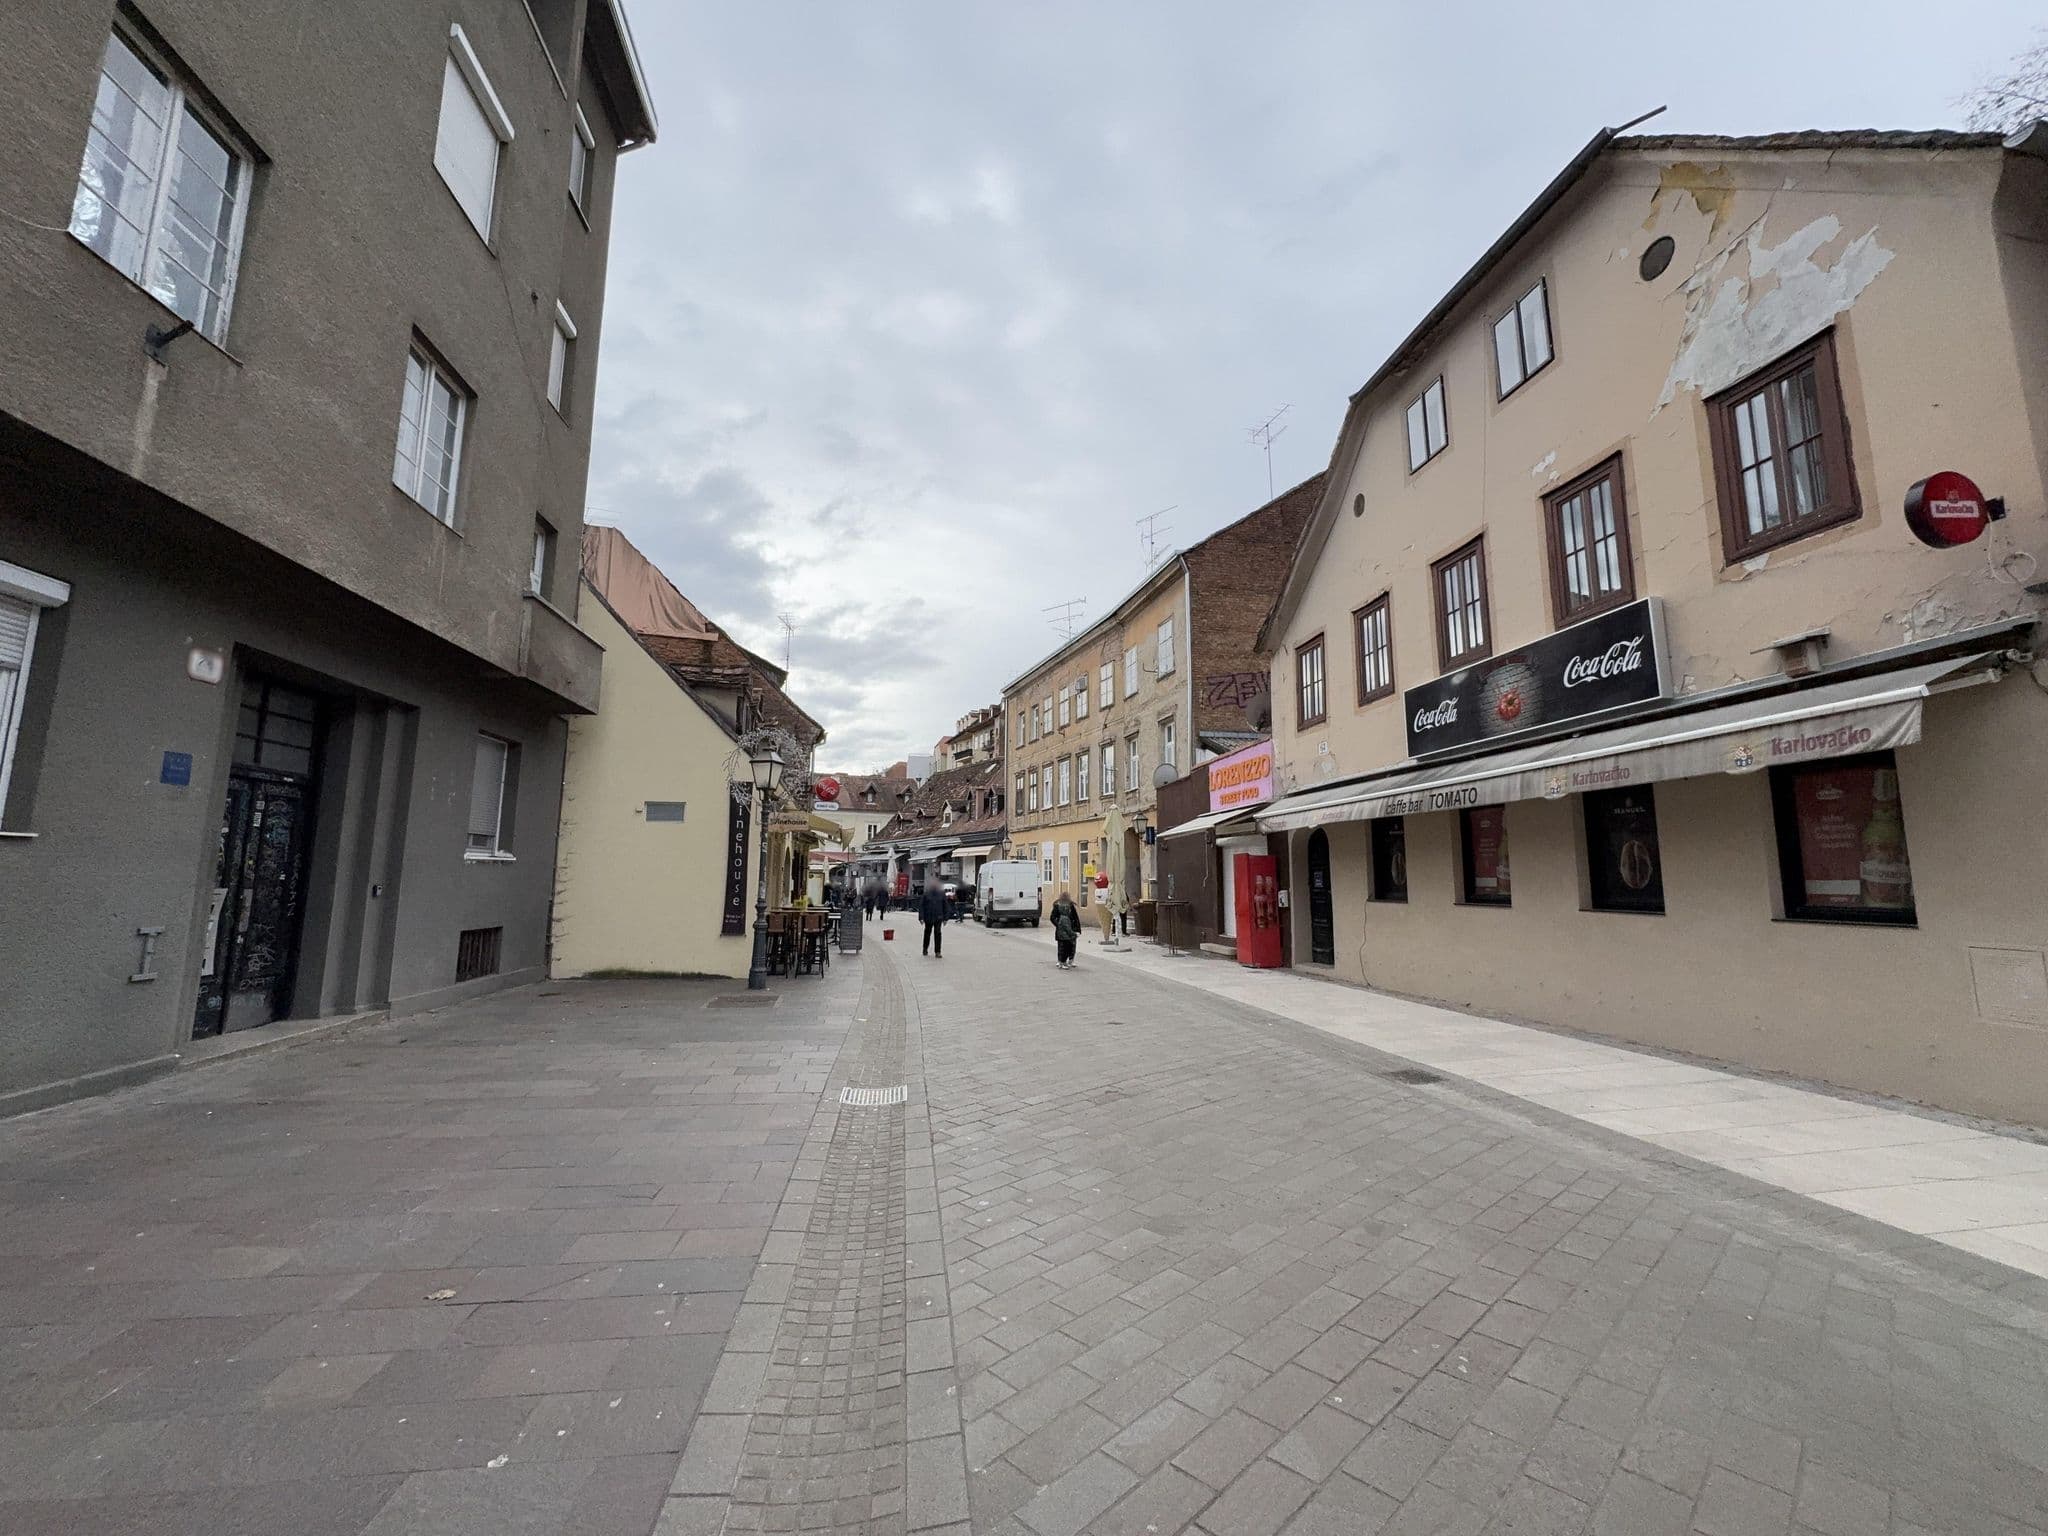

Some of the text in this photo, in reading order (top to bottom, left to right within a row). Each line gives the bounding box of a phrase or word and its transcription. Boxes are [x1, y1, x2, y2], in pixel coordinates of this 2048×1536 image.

[1563, 634, 1645, 688] Coca-Cola
[1414, 697, 1459, 733] Coca-Cola
[1771, 726, 1872, 757] Karlovačko
[1573, 764, 1630, 787] Karlovačko
[1408, 798, 1423, 813] bar
[1429, 787, 1478, 809] TOMATO
